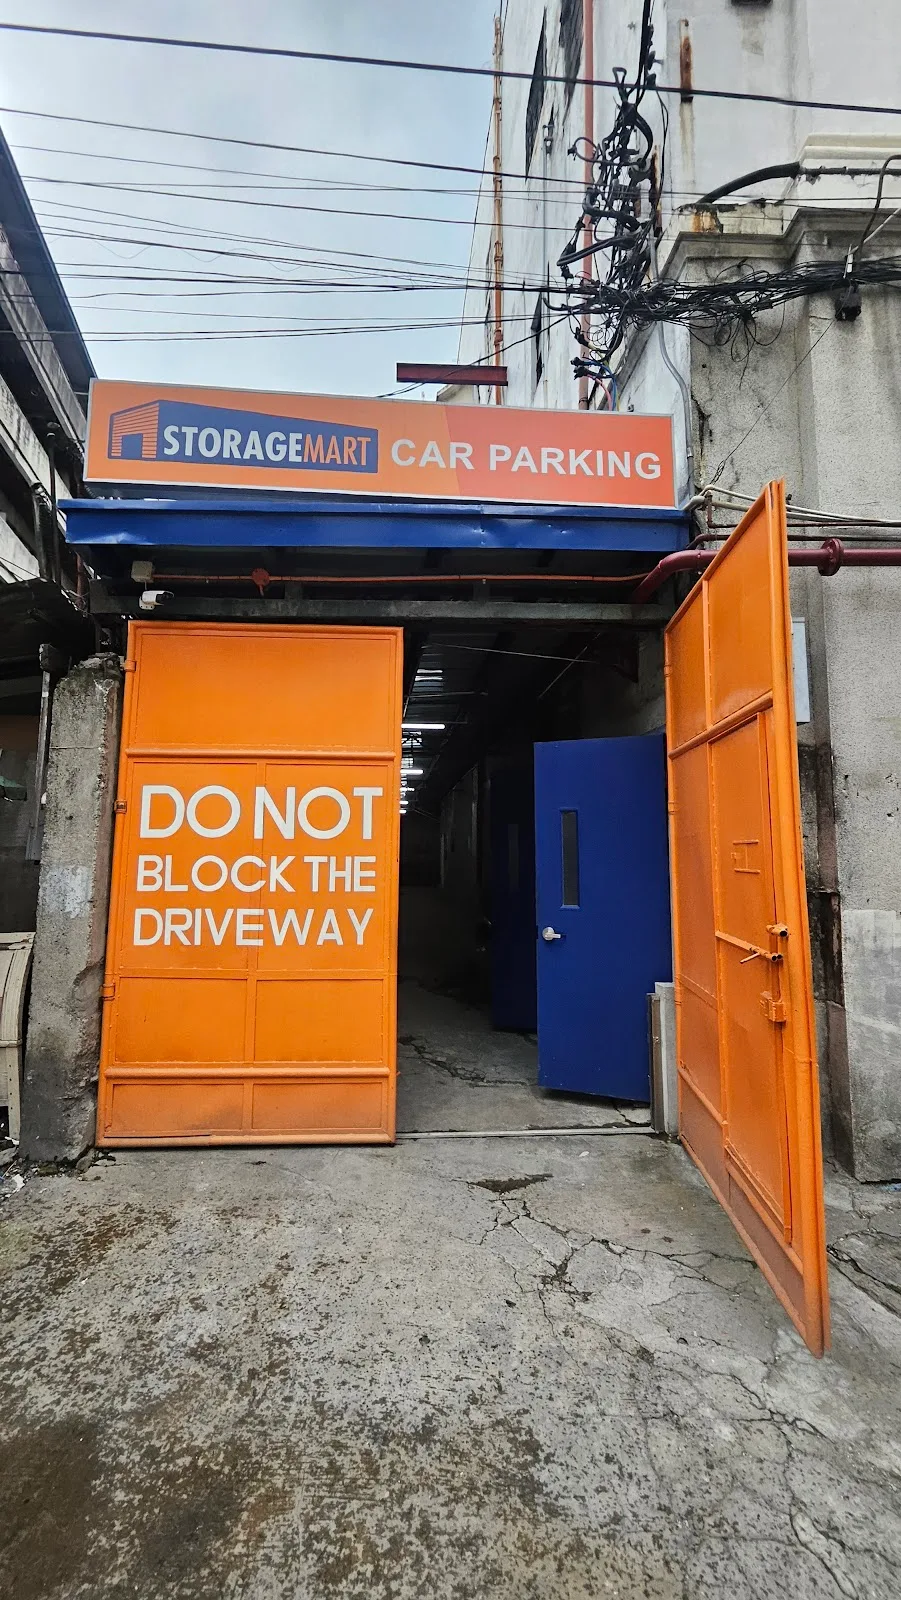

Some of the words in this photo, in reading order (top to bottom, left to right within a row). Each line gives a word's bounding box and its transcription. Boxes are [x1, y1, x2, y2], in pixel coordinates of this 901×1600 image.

[391, 437, 473, 471] CAR
[489, 444, 661, 480] PARKING
[140, 785, 241, 839] DO
[253, 786, 383, 840] NOT
[136, 855, 296, 892] BLOCK
[303, 855, 376, 892] THE
[133, 908, 374, 946] DRIVEWAY
